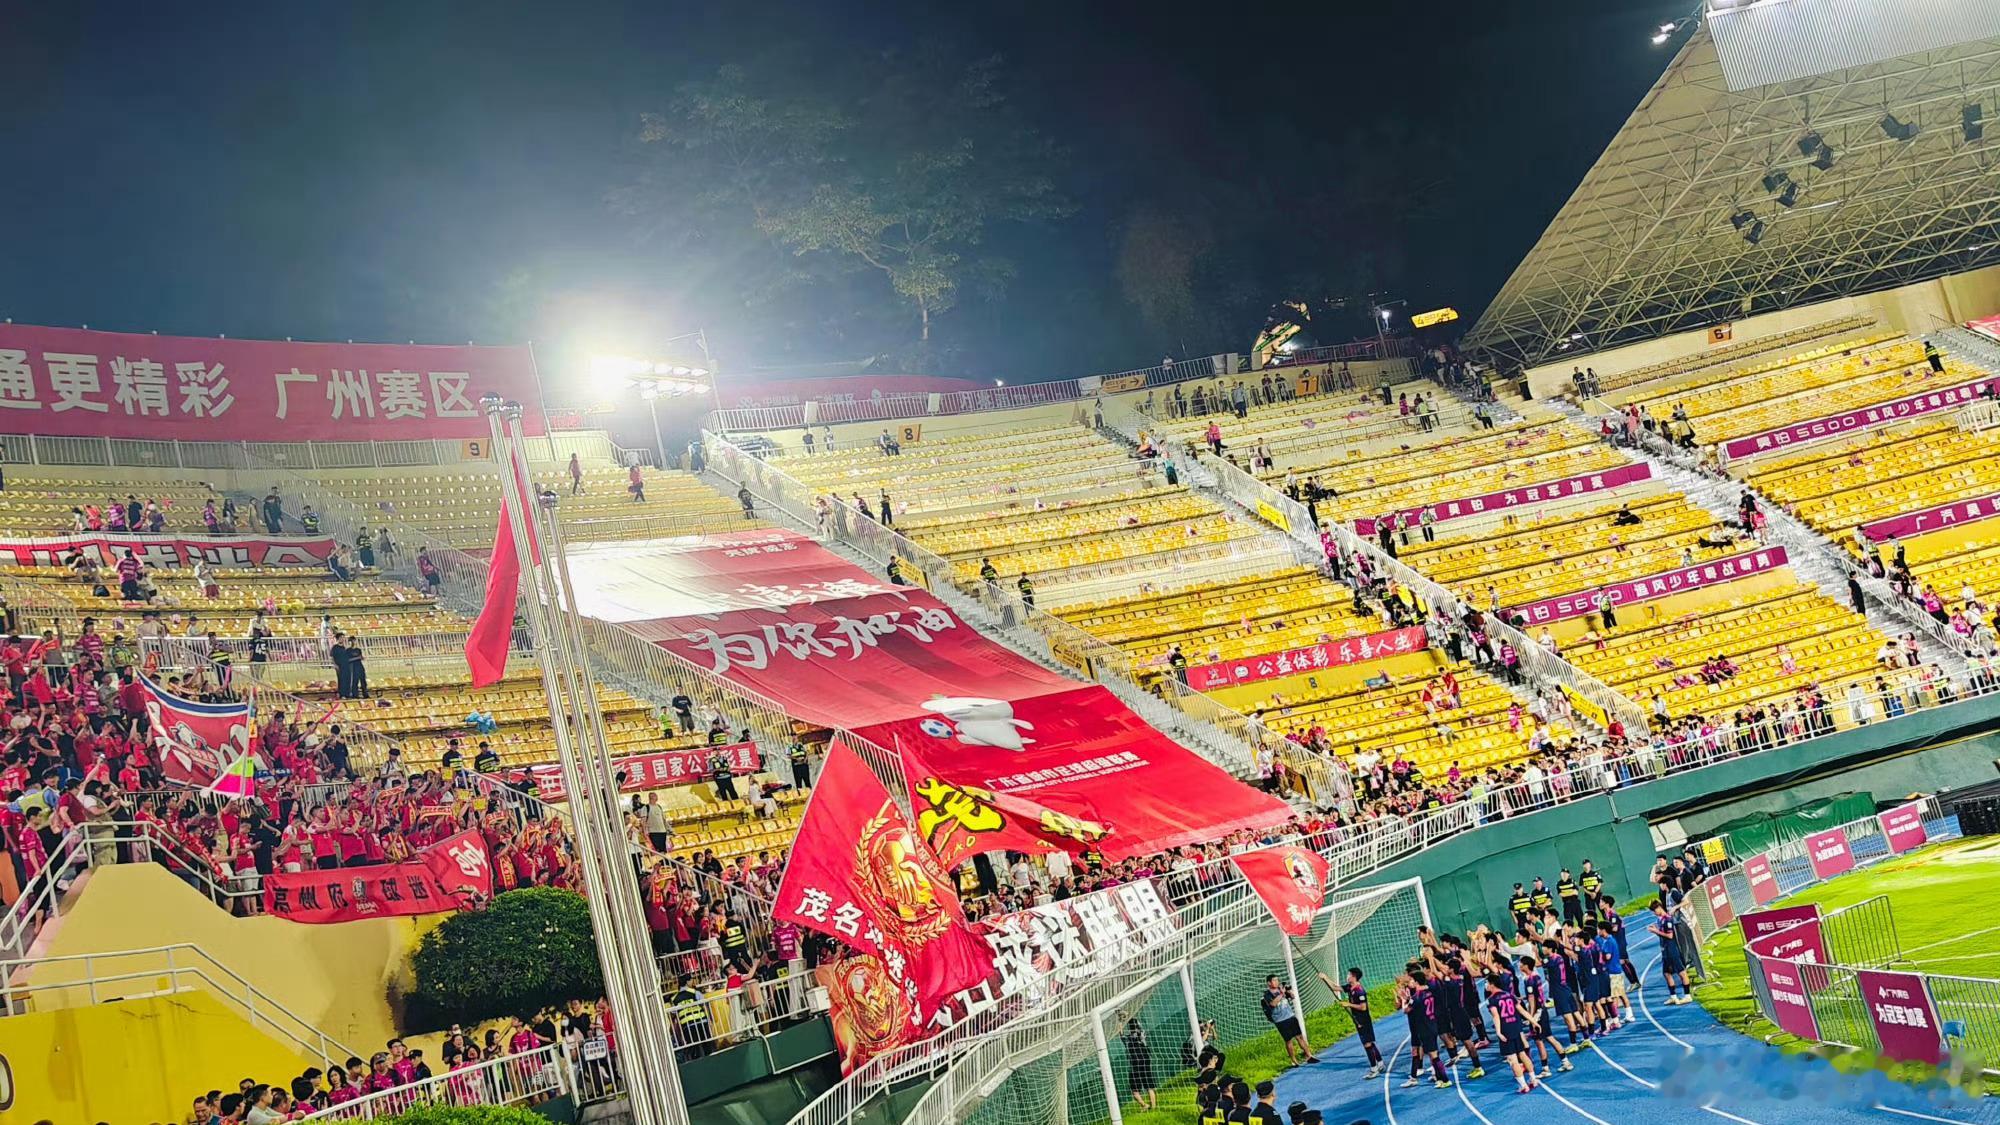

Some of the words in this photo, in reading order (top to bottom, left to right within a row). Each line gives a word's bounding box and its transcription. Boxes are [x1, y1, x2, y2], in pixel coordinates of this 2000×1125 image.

[1714, 329, 1724, 340] 6
[0, 348, 235, 418] 通更精彩
[275, 367, 480, 420] 广州赛区
[1302, 380, 1310, 392] 7
[904, 428, 914, 441] 8
[469, 442, 480, 457] 9
[679, 606, 967, 675] 为你加油
[1256, 645, 1330, 677] 公益体彩
[1339, 633, 1413, 662] 乐善人生
[1498, 998, 1516, 1018] 28
[1875, 1002, 1929, 1029] 为冠军加冕
